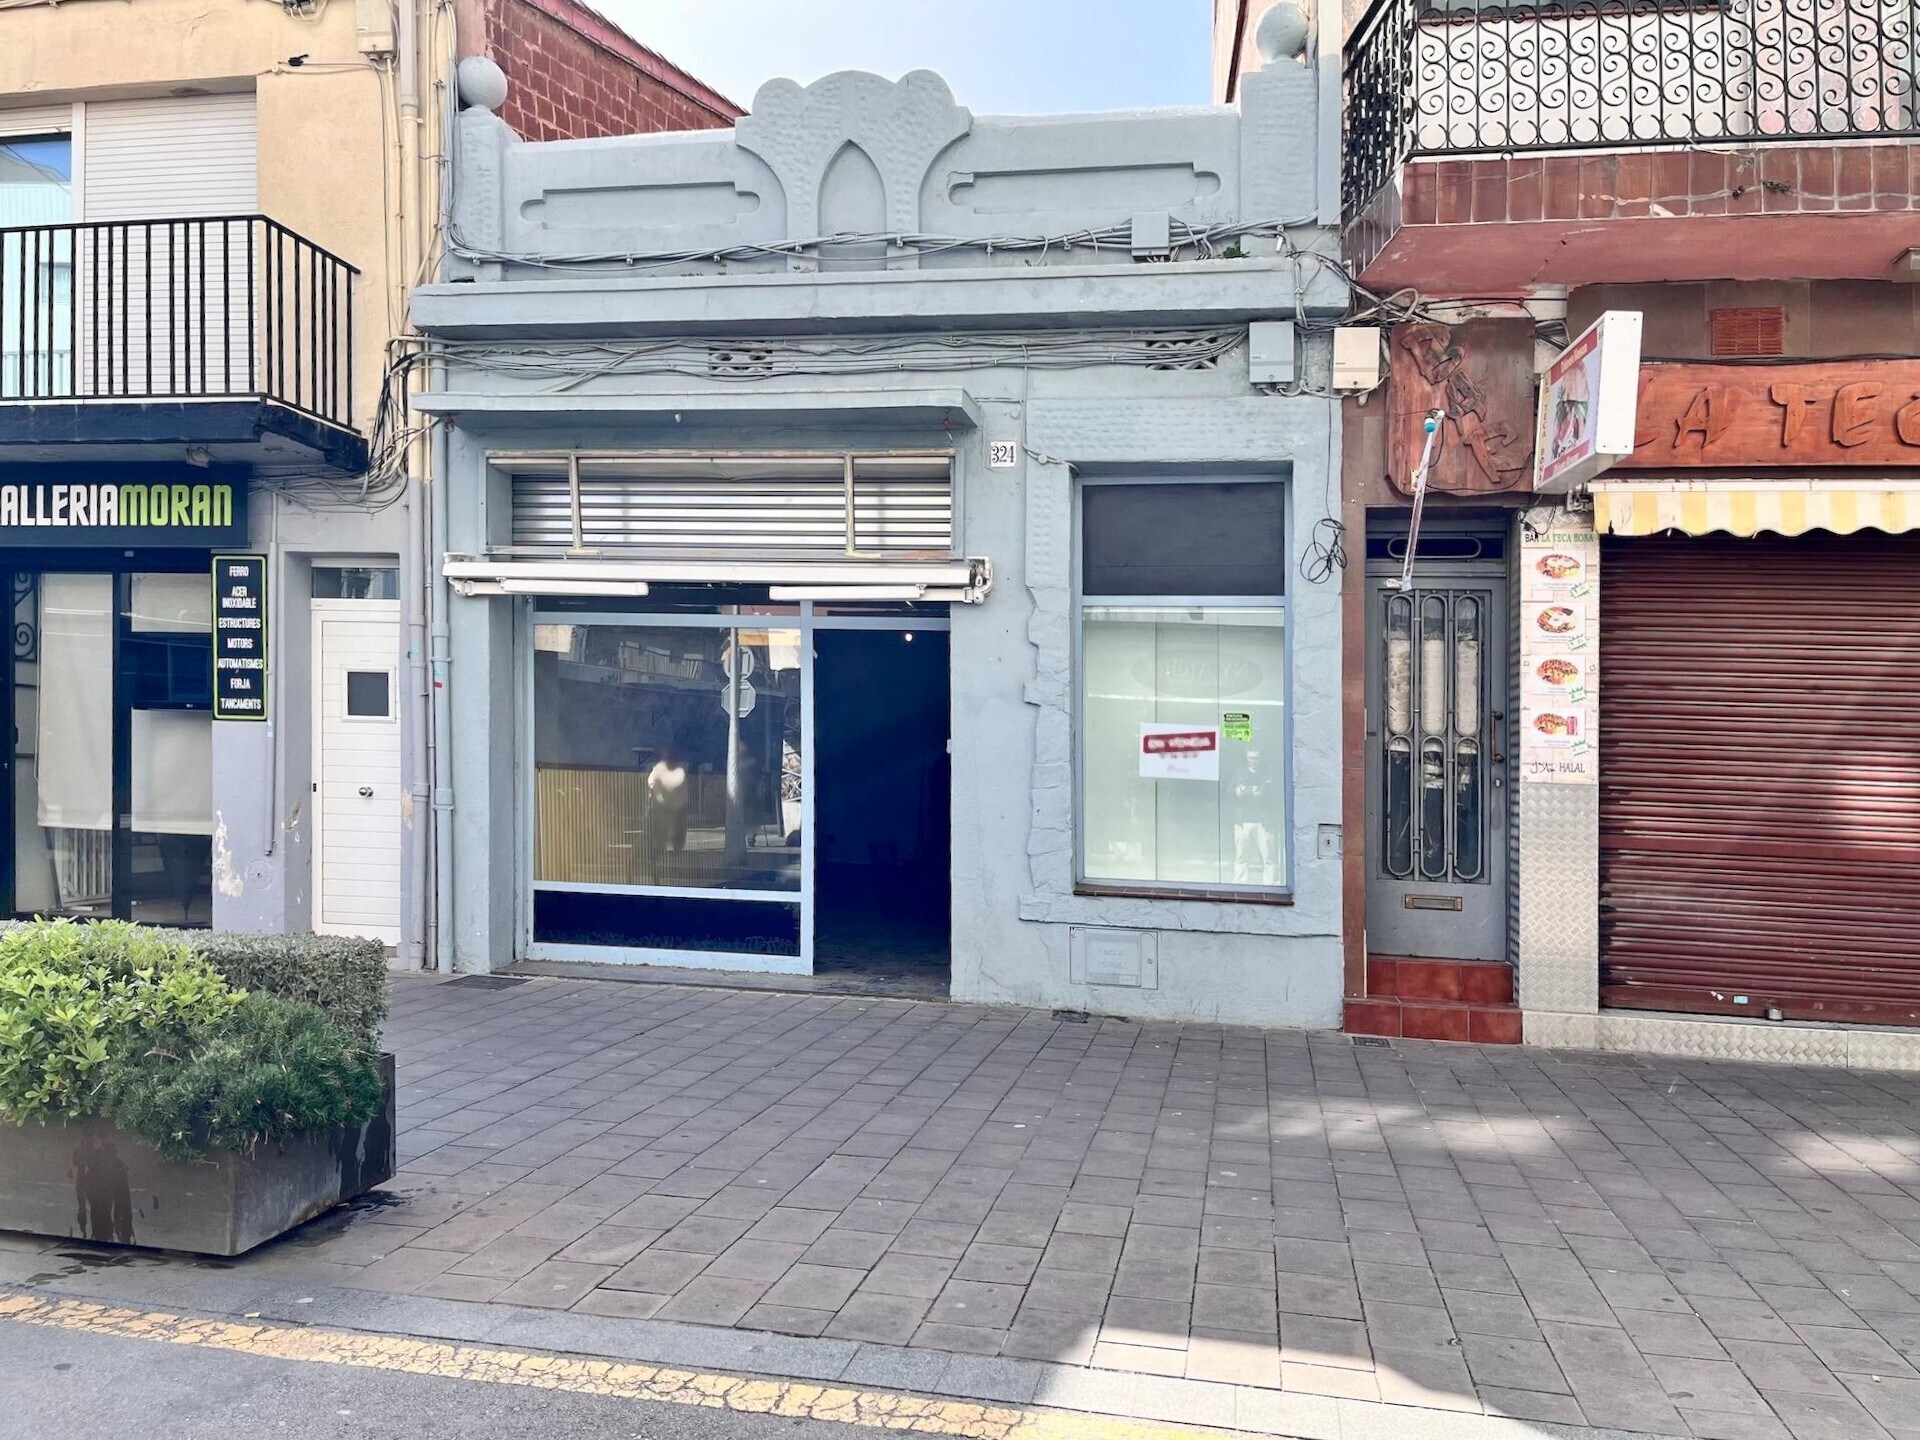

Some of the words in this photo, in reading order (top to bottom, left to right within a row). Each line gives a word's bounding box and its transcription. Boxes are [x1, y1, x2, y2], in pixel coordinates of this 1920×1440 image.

[991, 445, 1014, 463] 324
[1541, 533, 1551, 543] LA
[1552, 533, 1572, 544] TECA
[1573, 533, 1594, 543] BONA
[228, 565, 250, 577] FERRO
[231, 585, 248, 597] ACER
[222, 597, 257, 609] INOXIDABLE
[218, 617, 261, 629] ESTRUCTURES
[227, 637, 253, 649] MOTORS
[217, 657, 264, 669] AUTOMATISMES
[230, 677, 251, 689] FORJA
[220, 697, 262, 709] TANCAMENTS
[1559, 762, 1586, 773] HALAL
